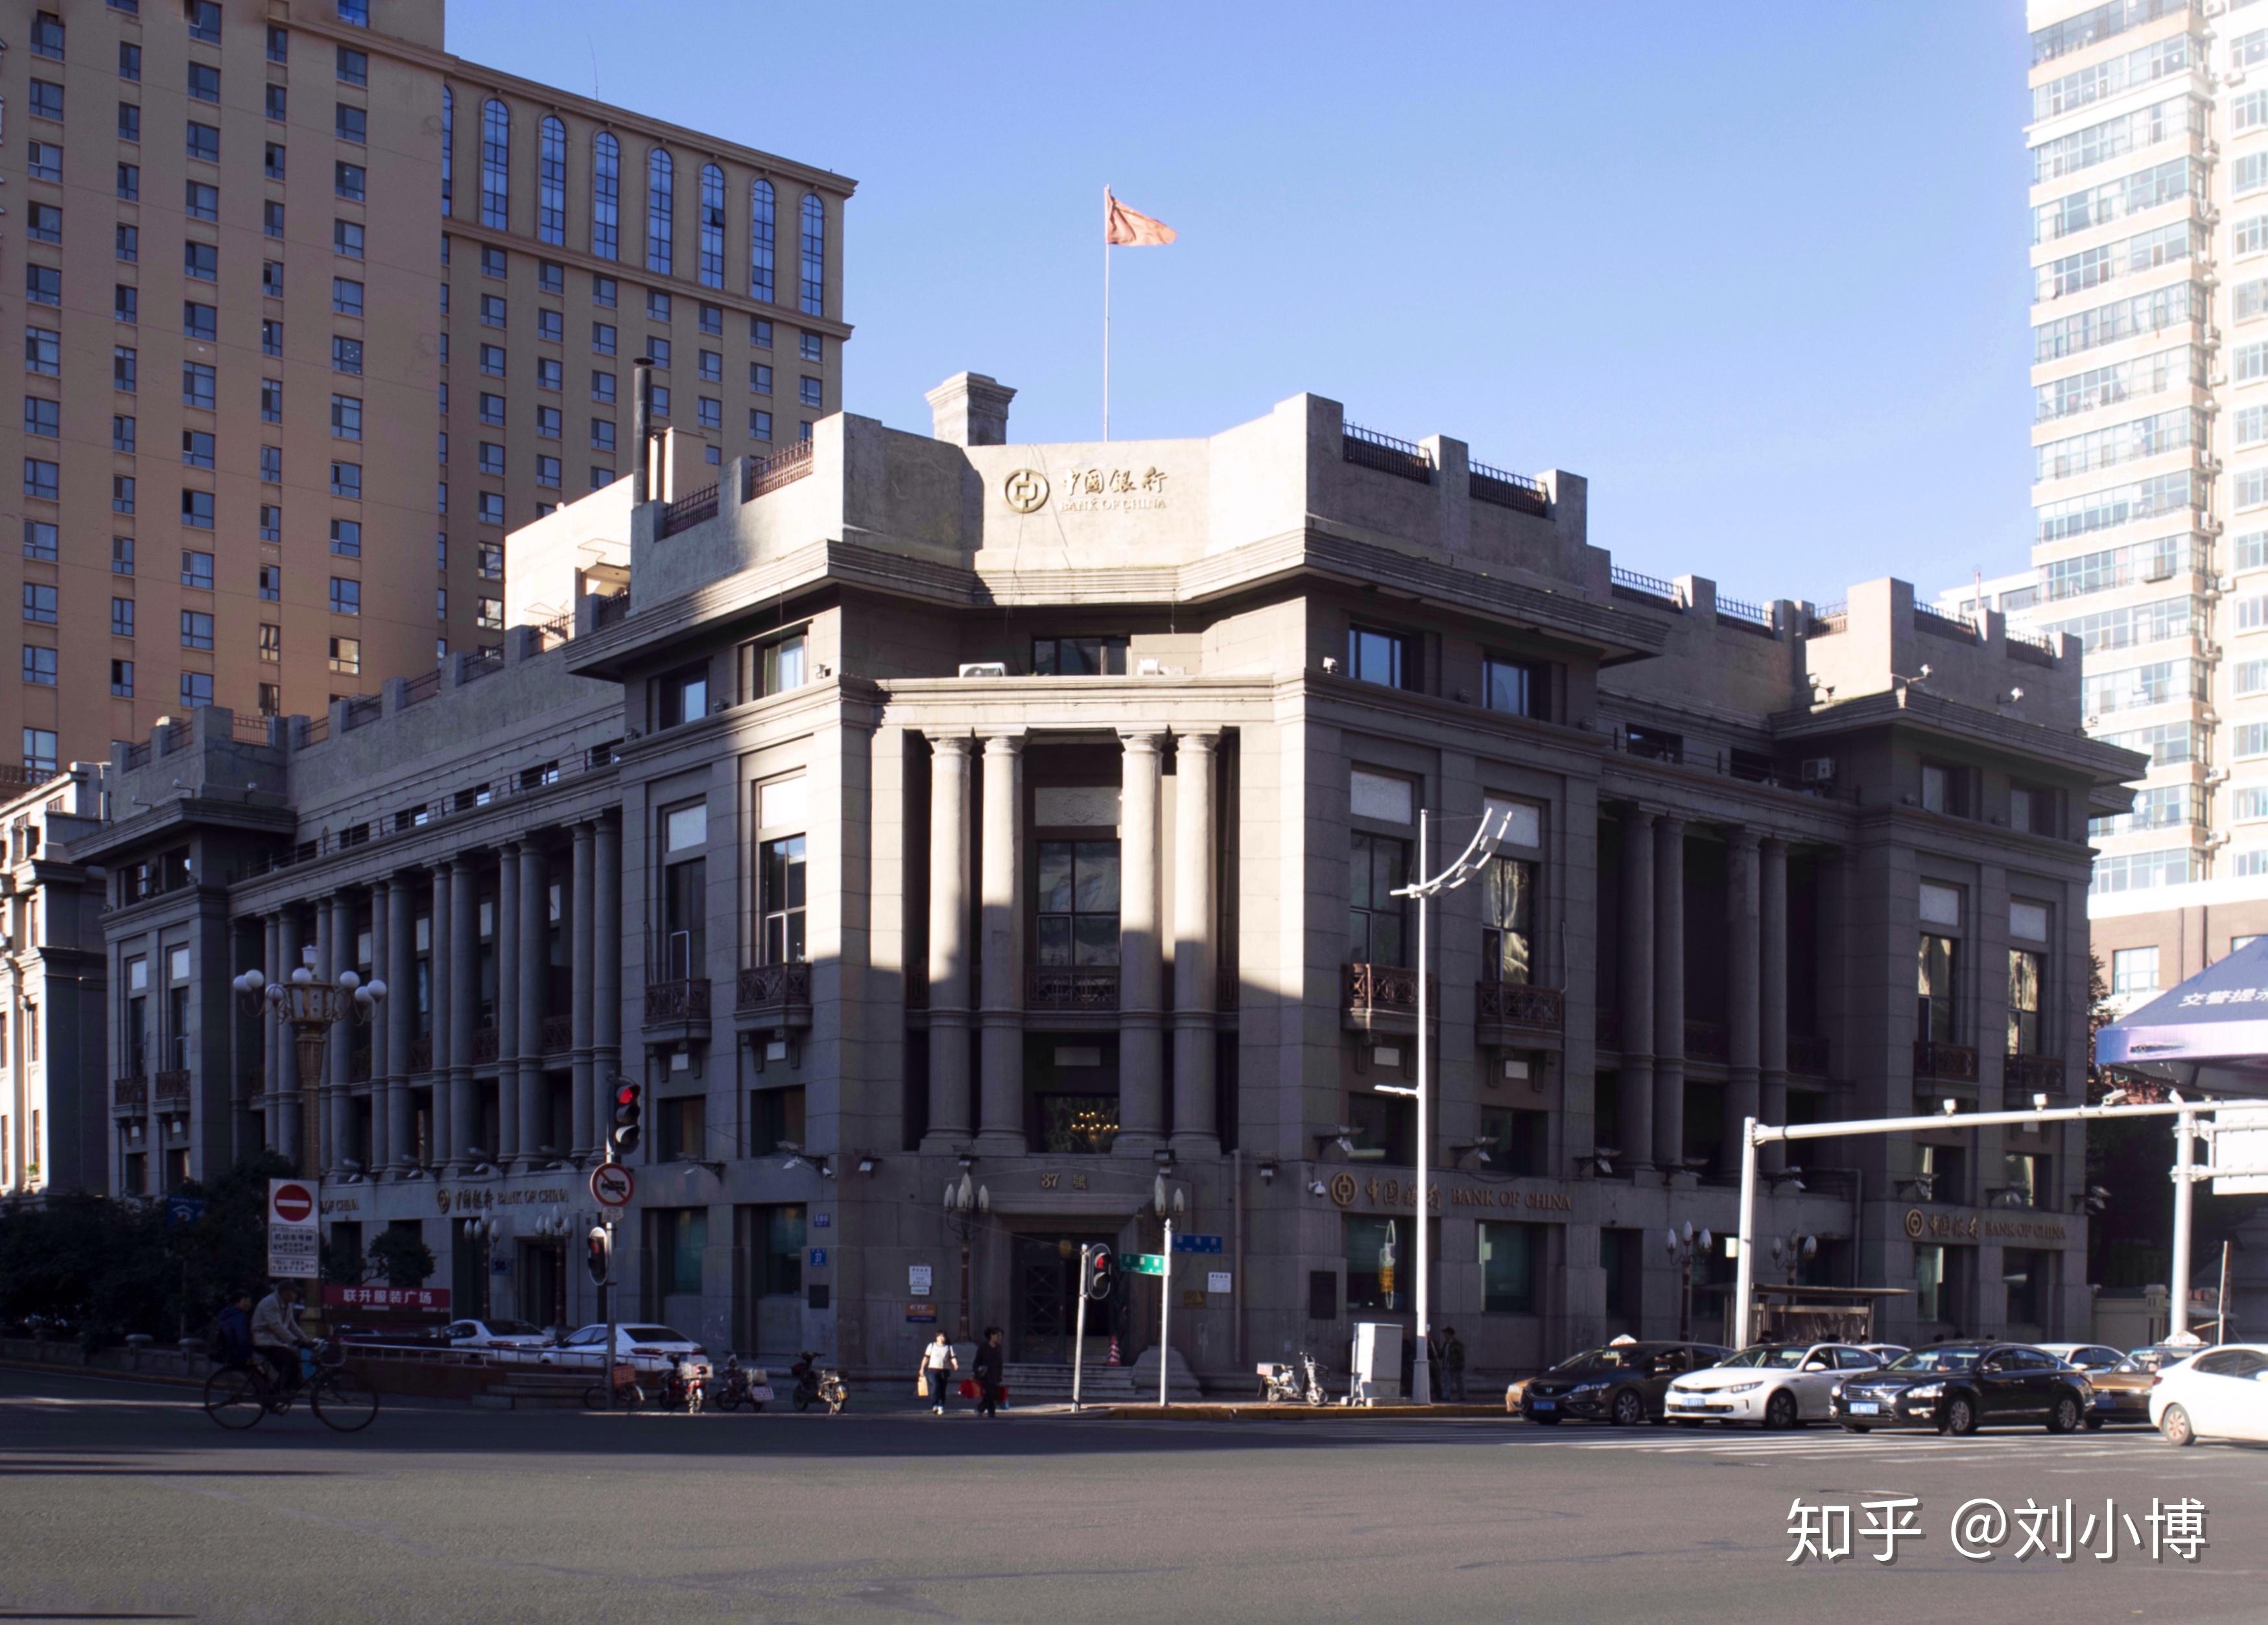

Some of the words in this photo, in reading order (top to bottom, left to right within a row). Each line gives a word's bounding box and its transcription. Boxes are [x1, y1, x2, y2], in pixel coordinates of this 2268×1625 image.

[1061, 500, 1098, 512] BANK
[1102, 499, 1120, 511] OF
[1123, 498, 1167, 511] CHINA
[1042, 1173, 1060, 1188] 37
[497, 1191, 523, 1205] BANK
[525, 1190, 537, 1204] OF
[539, 1188, 569, 1203] CHINA
[1452, 1187, 1494, 1206] BANK
[1500, 1191, 1519, 1208] OF
[1525, 1193, 1572, 1211] CHINA
[1986, 1222, 2014, 1237] BANK
[2017, 1222, 2032, 1238] OF
[2033, 1224, 2066, 1239] CHINA
[343, 1289, 432, 1305] 联升服装广场
